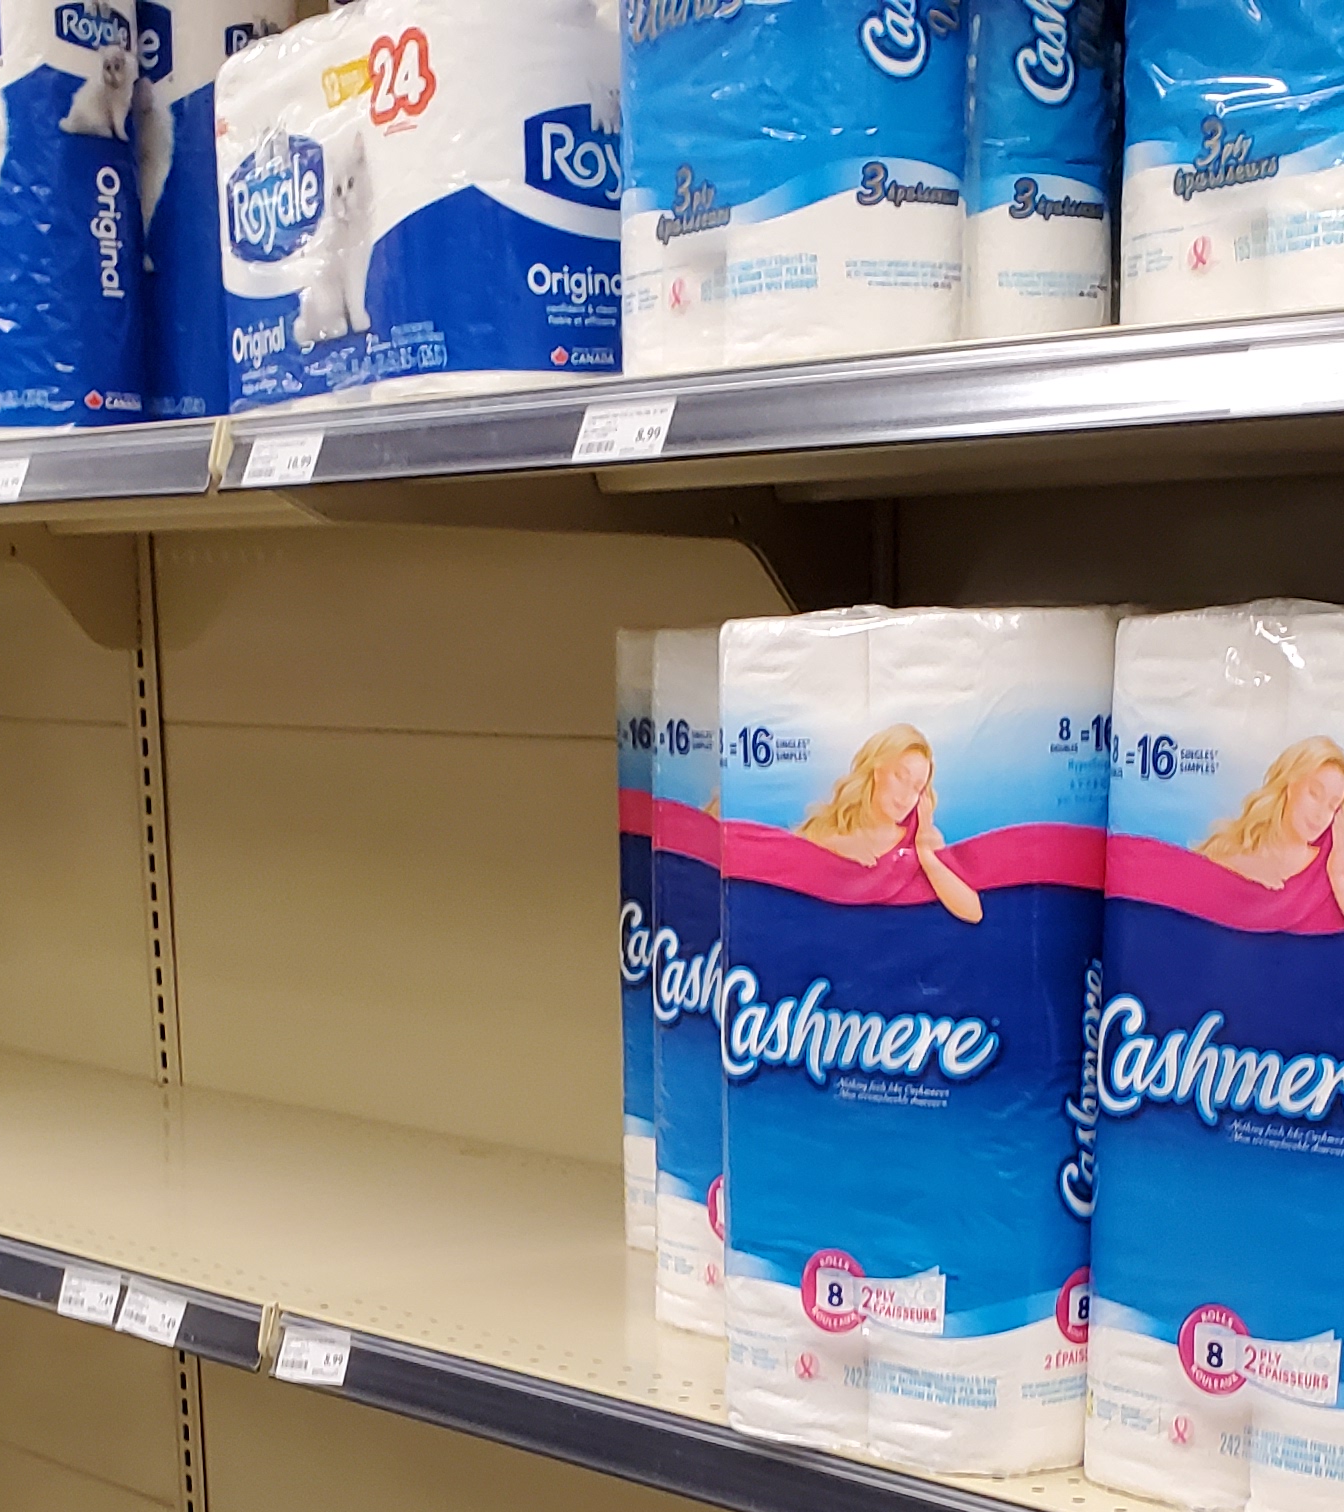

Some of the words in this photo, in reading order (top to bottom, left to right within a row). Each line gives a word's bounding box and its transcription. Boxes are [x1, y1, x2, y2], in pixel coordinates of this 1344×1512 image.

[63, 9, 128, 48] Royale
[371, 34, 431, 118] 24
[856, 160, 888, 208] 3
[1009, 177, 1039, 220] 3
[233, 166, 318, 254] Royale
[89, 165, 126, 299] Original
[232, 316, 285, 368] Original
[570, 350, 615, 366] CANADA
[1058, 717, 1071, 741] 8
[721, 967, 998, 1085] Cashmere
[826, 1281, 844, 1308] 8
[861, 1286, 874, 1311] 2
[873, 1287, 896, 1305] PLY
[873, 1300, 938, 1325] ÉPAISSEURS
[1206, 1340, 1224, 1368] 8
[1244, 1344, 1257, 1373] 2
[1258, 1348, 1283, 1367] PLY
[1257, 1362, 1329, 1391] ÉPAISSEURS
